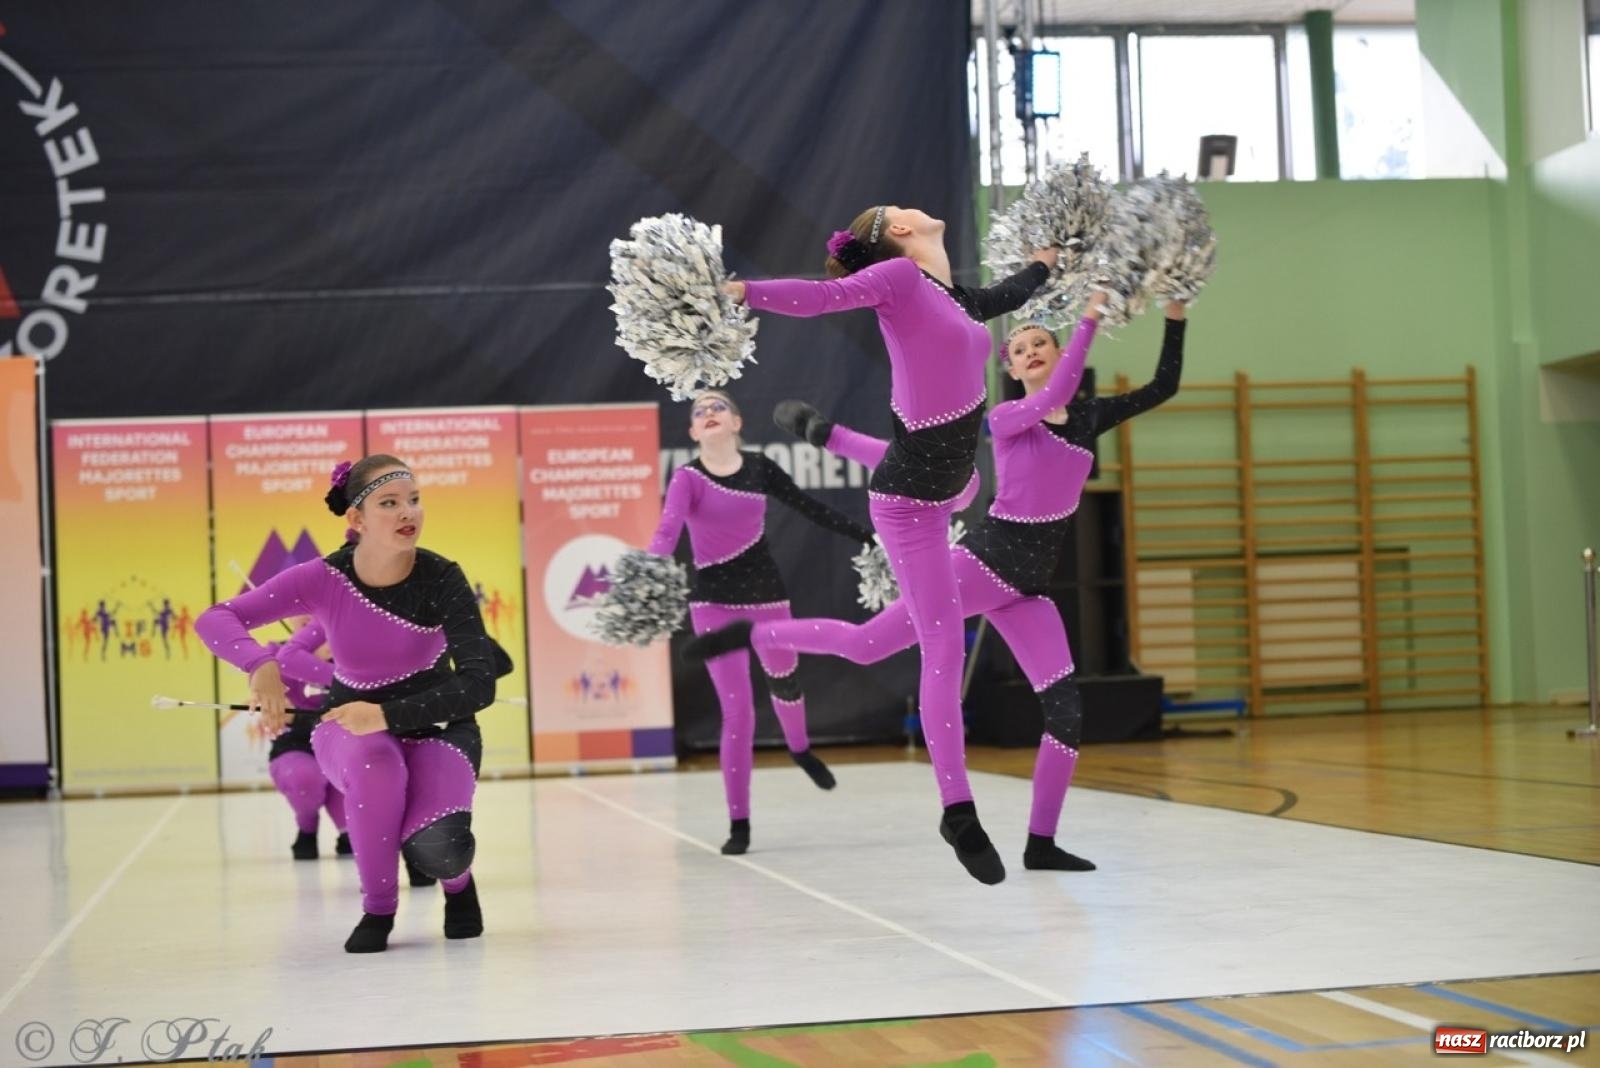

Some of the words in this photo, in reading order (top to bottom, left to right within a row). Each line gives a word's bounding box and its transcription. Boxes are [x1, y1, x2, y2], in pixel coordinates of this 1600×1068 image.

[0, 76, 107, 360] ORETEK
[243, 425, 329, 440] EUROPEAN
[379, 417, 502, 434] INTERNATIONAL
[67, 431, 191, 449] INTERNATIONAL
[394, 435, 489, 451] FEDERATION
[81, 449, 179, 466] FEDERATION
[225, 440, 348, 458] CHAMPIONSHIP
[547, 447, 634, 464] EUROPEAN
[79, 467, 182, 485] MAJORETTES
[529, 464, 652, 483] CHAMPIONSHIP
[104, 486, 157, 502] SPORT
[261, 478, 313, 493] SPORT
[541, 484, 643, 502] MAJORETTES
[569, 502, 621, 519] SPORT
